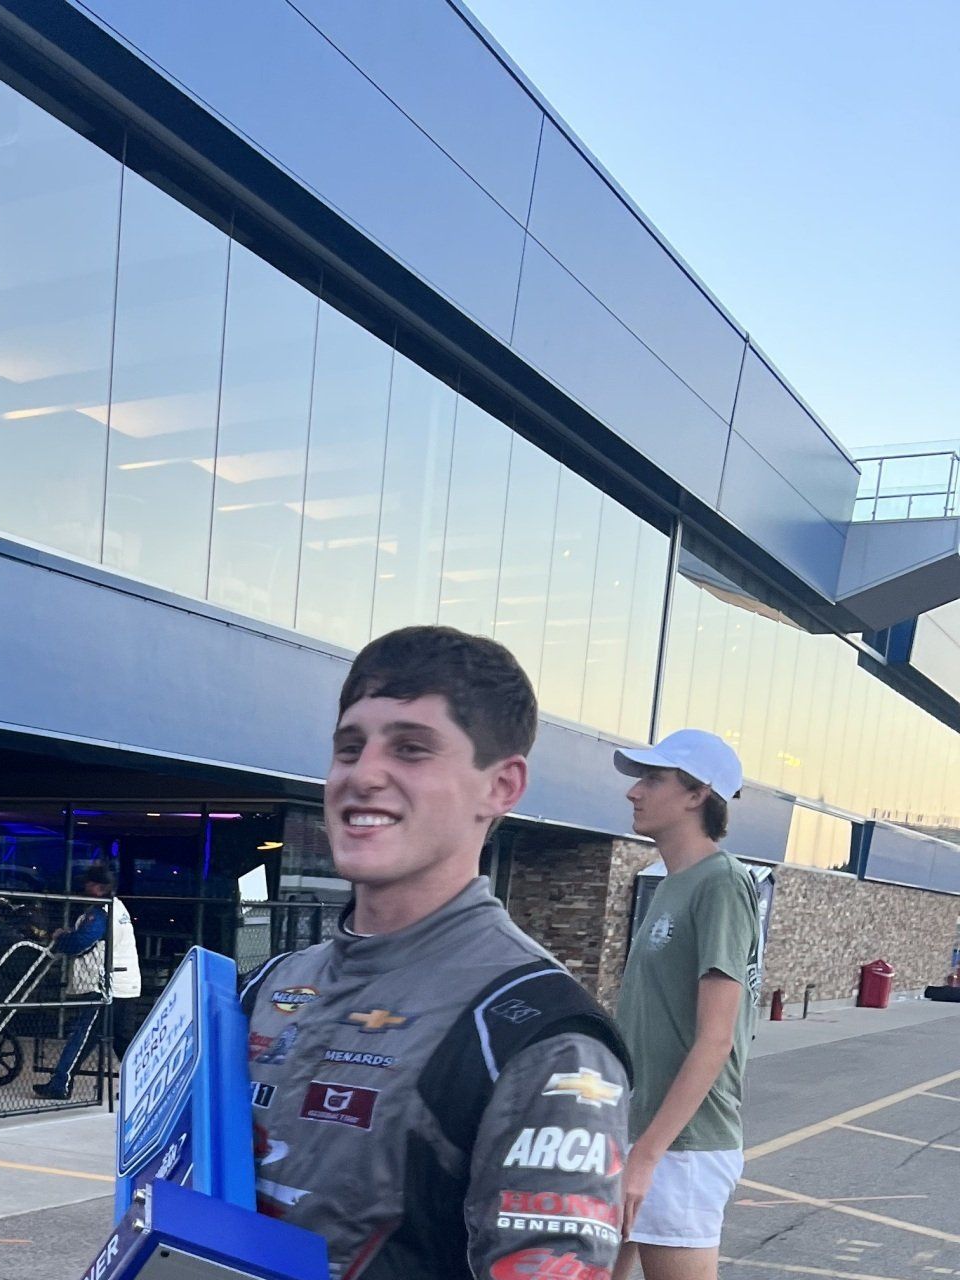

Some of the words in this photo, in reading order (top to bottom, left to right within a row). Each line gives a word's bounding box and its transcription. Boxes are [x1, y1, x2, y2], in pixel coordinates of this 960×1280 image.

[132, 991, 178, 1067] HENRY
[133, 1024, 168, 1081] FORD
[133, 1013, 187, 1099] HEALTH
[323, 1050, 393, 1068] MENARDS
[128, 1036, 190, 1143] 200
[503, 1126, 607, 1176] ARCA
